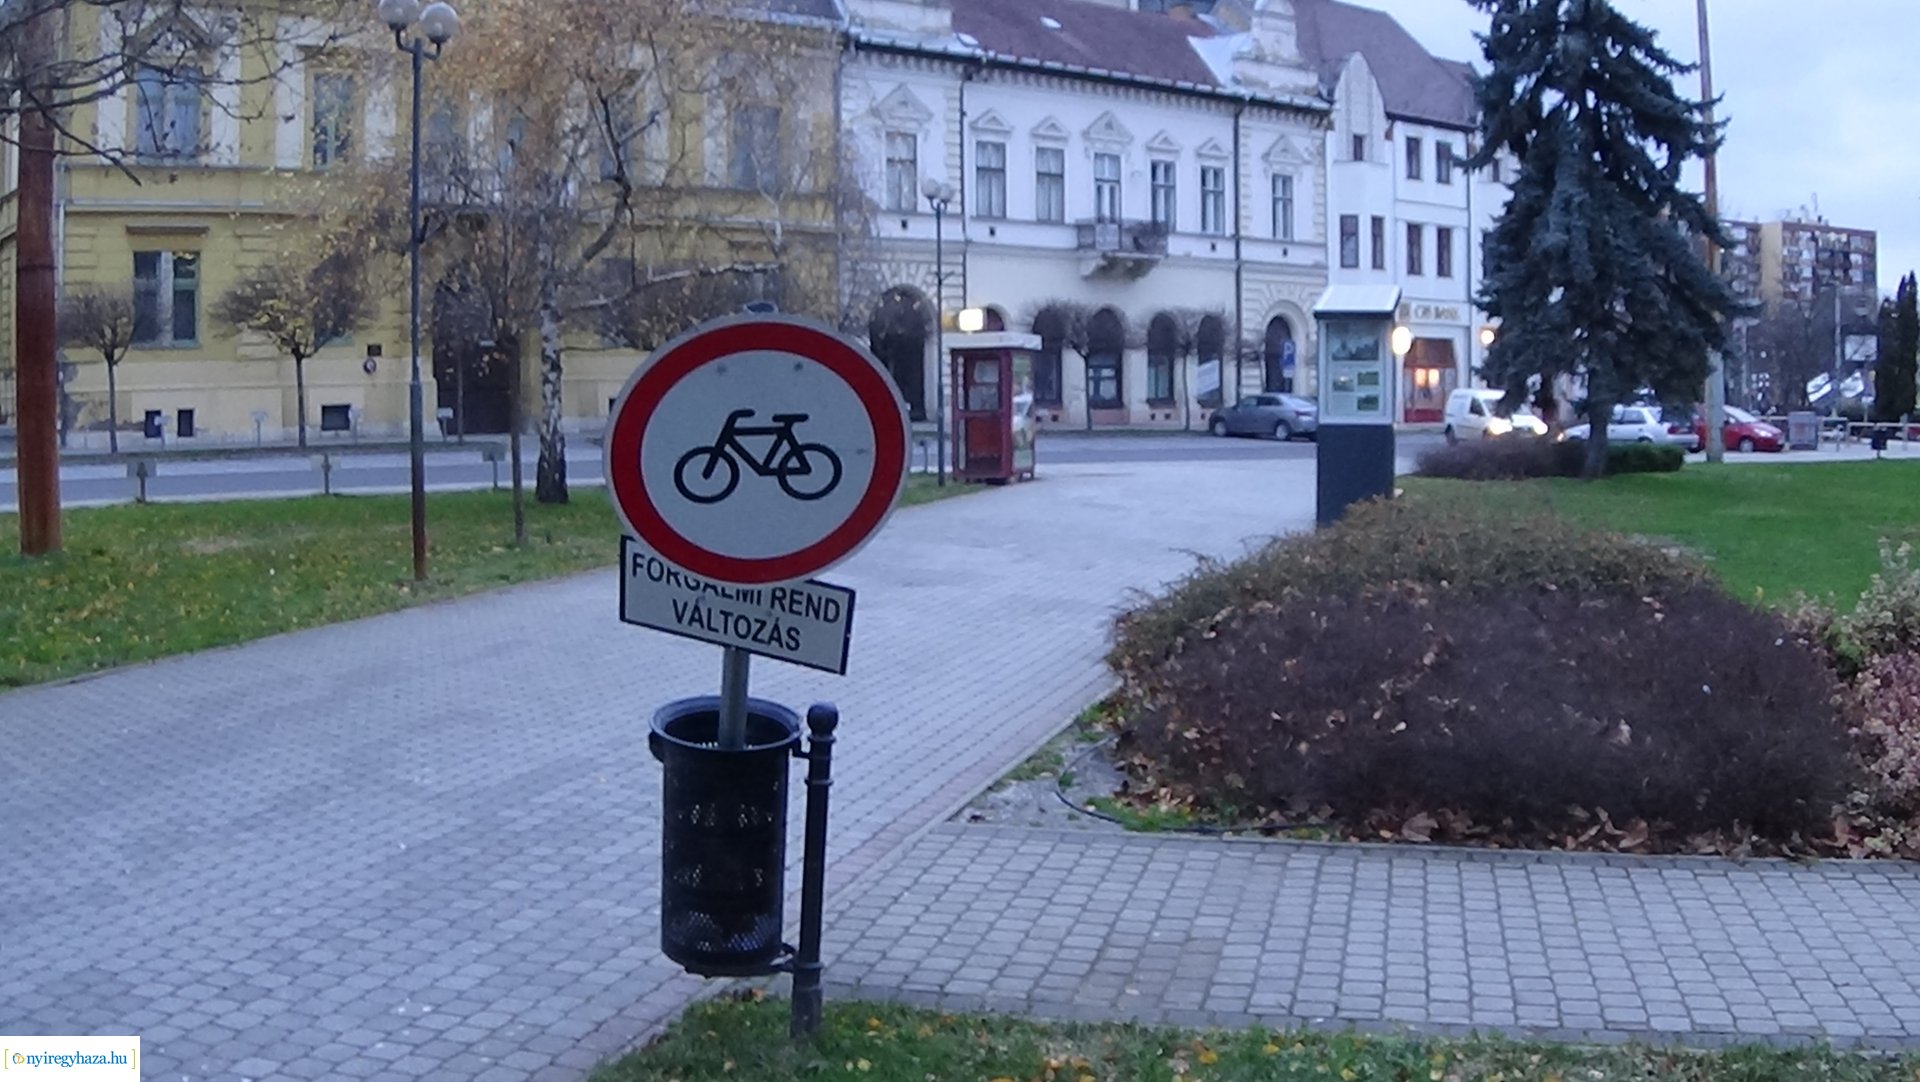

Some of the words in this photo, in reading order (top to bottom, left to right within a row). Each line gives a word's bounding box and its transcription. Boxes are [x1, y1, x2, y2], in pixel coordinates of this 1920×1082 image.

[1283, 342, 1294, 360] P
[672, 595, 801, 651] VÁLTOZÁS
[770, 587, 841, 624] REND
